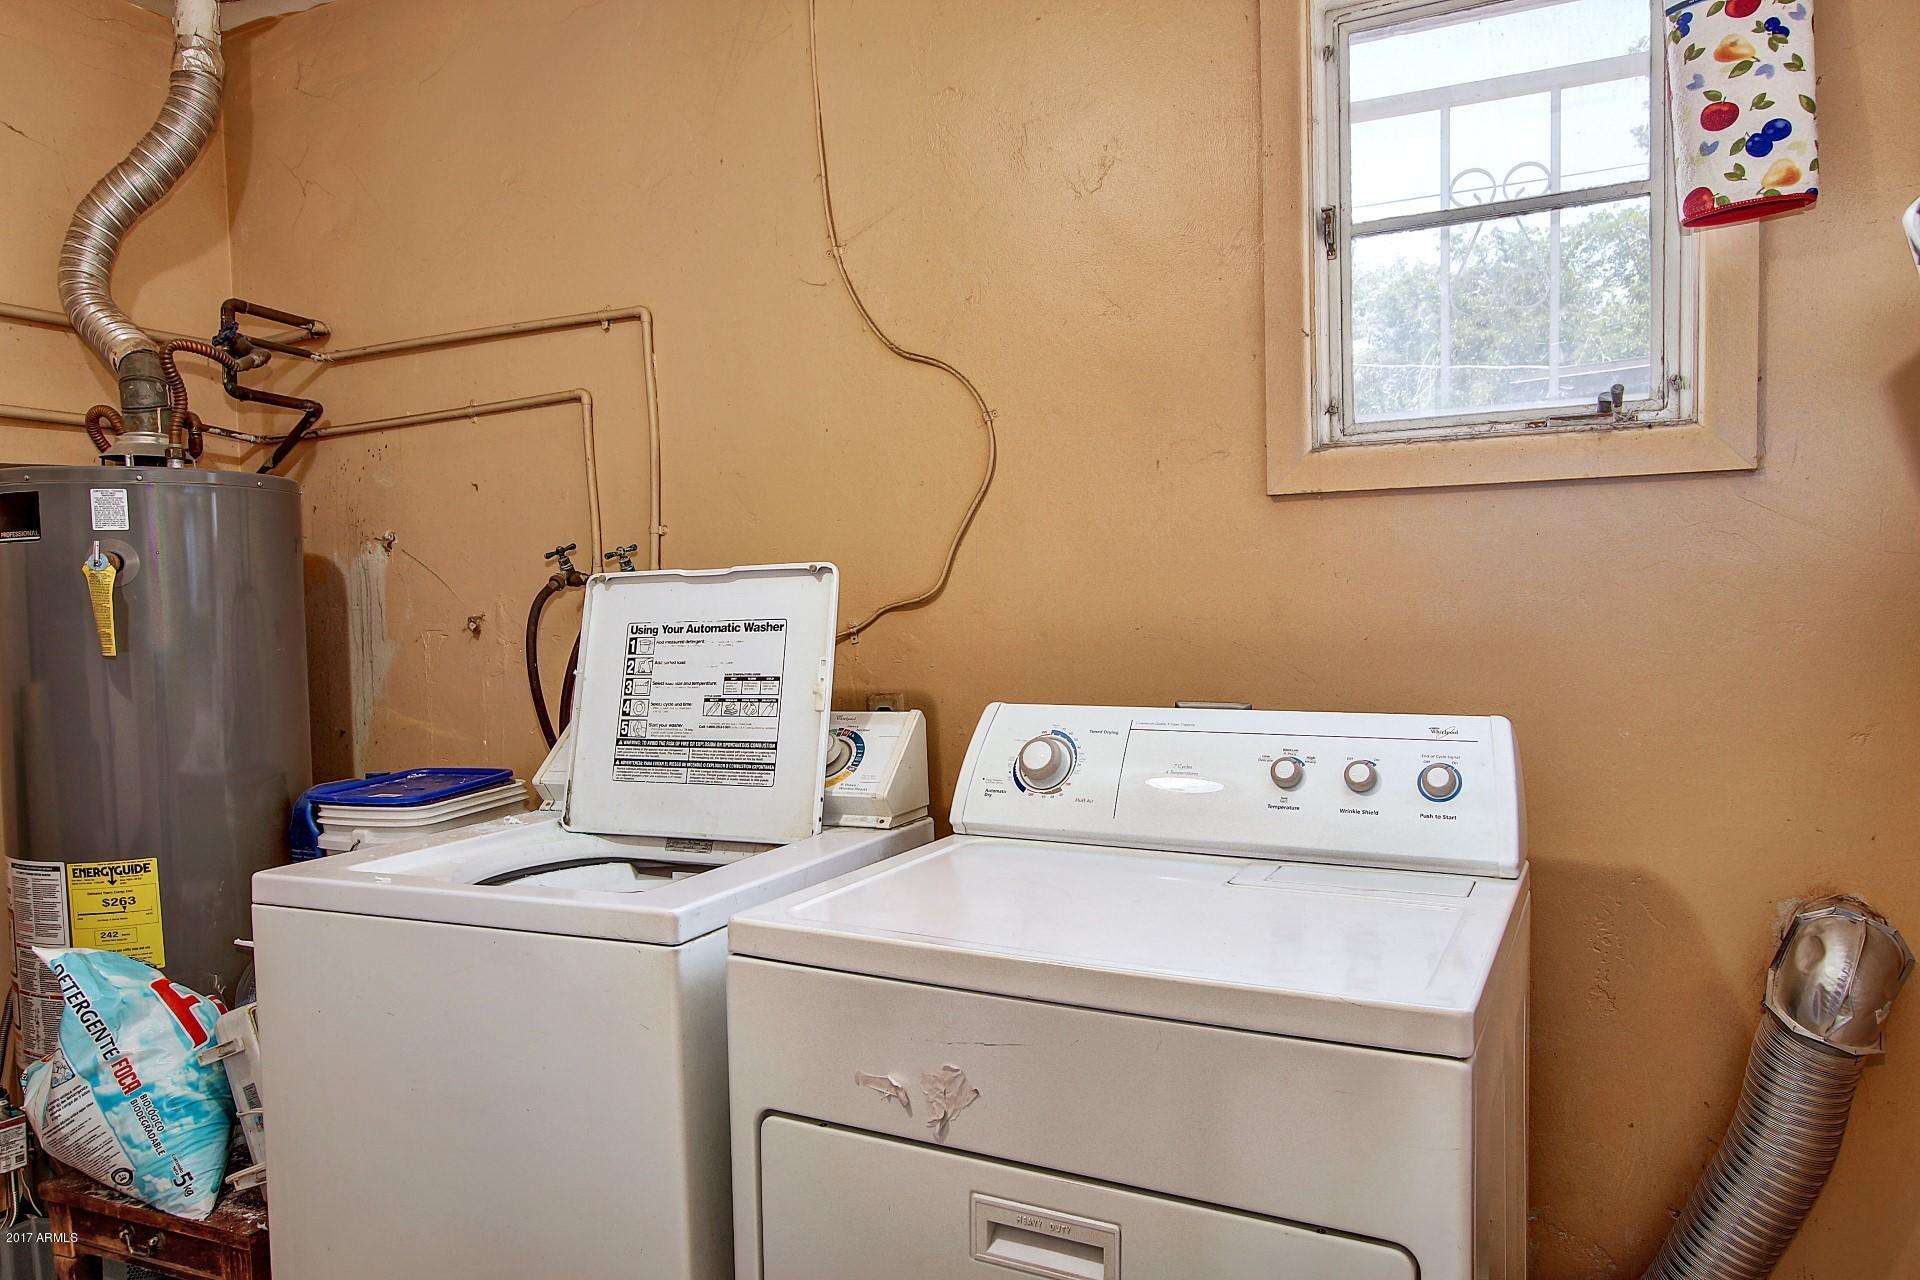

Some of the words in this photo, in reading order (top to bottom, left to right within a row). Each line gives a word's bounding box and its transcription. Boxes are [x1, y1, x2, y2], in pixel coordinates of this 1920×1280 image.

[0, 529, 40, 538] PROFESSIONAL
[630, 625, 659, 636] Using
[661, 624, 684, 635] Your
[686, 623, 741, 634] Automatic
[743, 622, 785, 633] Washer
[630, 640, 636, 653] 1
[626, 660, 634, 674] 2
[625, 680, 632, 694] 3
[622, 700, 630, 714] 4
[620, 721, 628, 735] 5
[1430, 728, 1459, 736] Whirlpool
[1267, 803, 1300, 811] Temperature
[102, 896, 136, 907] $263
[100, 931, 119, 939] 242
[54, 962, 120, 1061] DETERGENTE
[111, 1057, 142, 1096] FOCA
[139, 1092, 165, 1133] BIOLÓGICO
[129, 1098, 166, 1157] BIODEGRADABLE
[1016, 1214, 1043, 1228] HEAVY
[1049, 1221, 1072, 1235] DUTY
